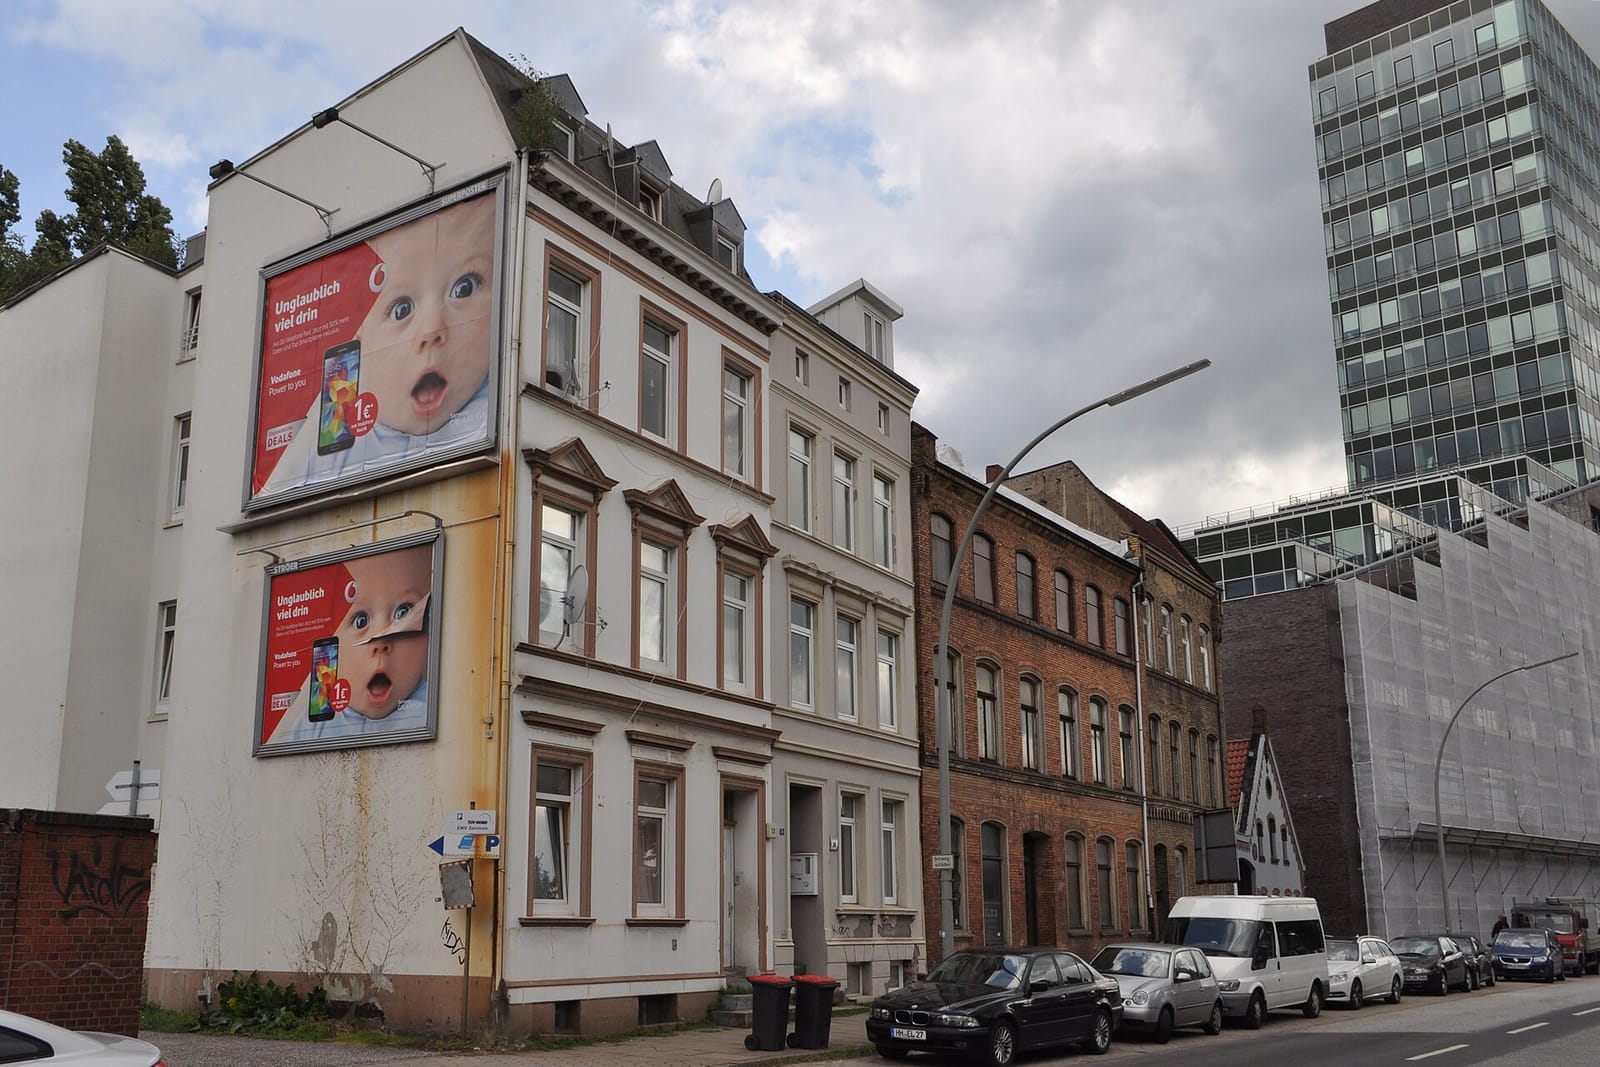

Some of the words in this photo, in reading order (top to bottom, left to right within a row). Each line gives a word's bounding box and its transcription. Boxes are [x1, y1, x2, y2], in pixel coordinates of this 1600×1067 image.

[441, 183, 488, 206] SUPERPOSTER
[275, 281, 340, 315] Unglaublich
[274, 315, 294, 333] viel
[296, 307, 318, 325] drin
[270, 369, 301, 385] Vodafone
[269, 384, 287, 396] Power
[287, 382, 294, 391] to
[294, 378, 307, 391] you
[267, 432, 293, 447] DEALS
[277, 587, 325, 607] Unglaublich
[277, 608, 292, 621] viel
[292, 605, 308, 617] drin
[292, 660, 301, 668] you
[272, 699, 291, 709] DEALS
[486, 835, 500, 852] P
